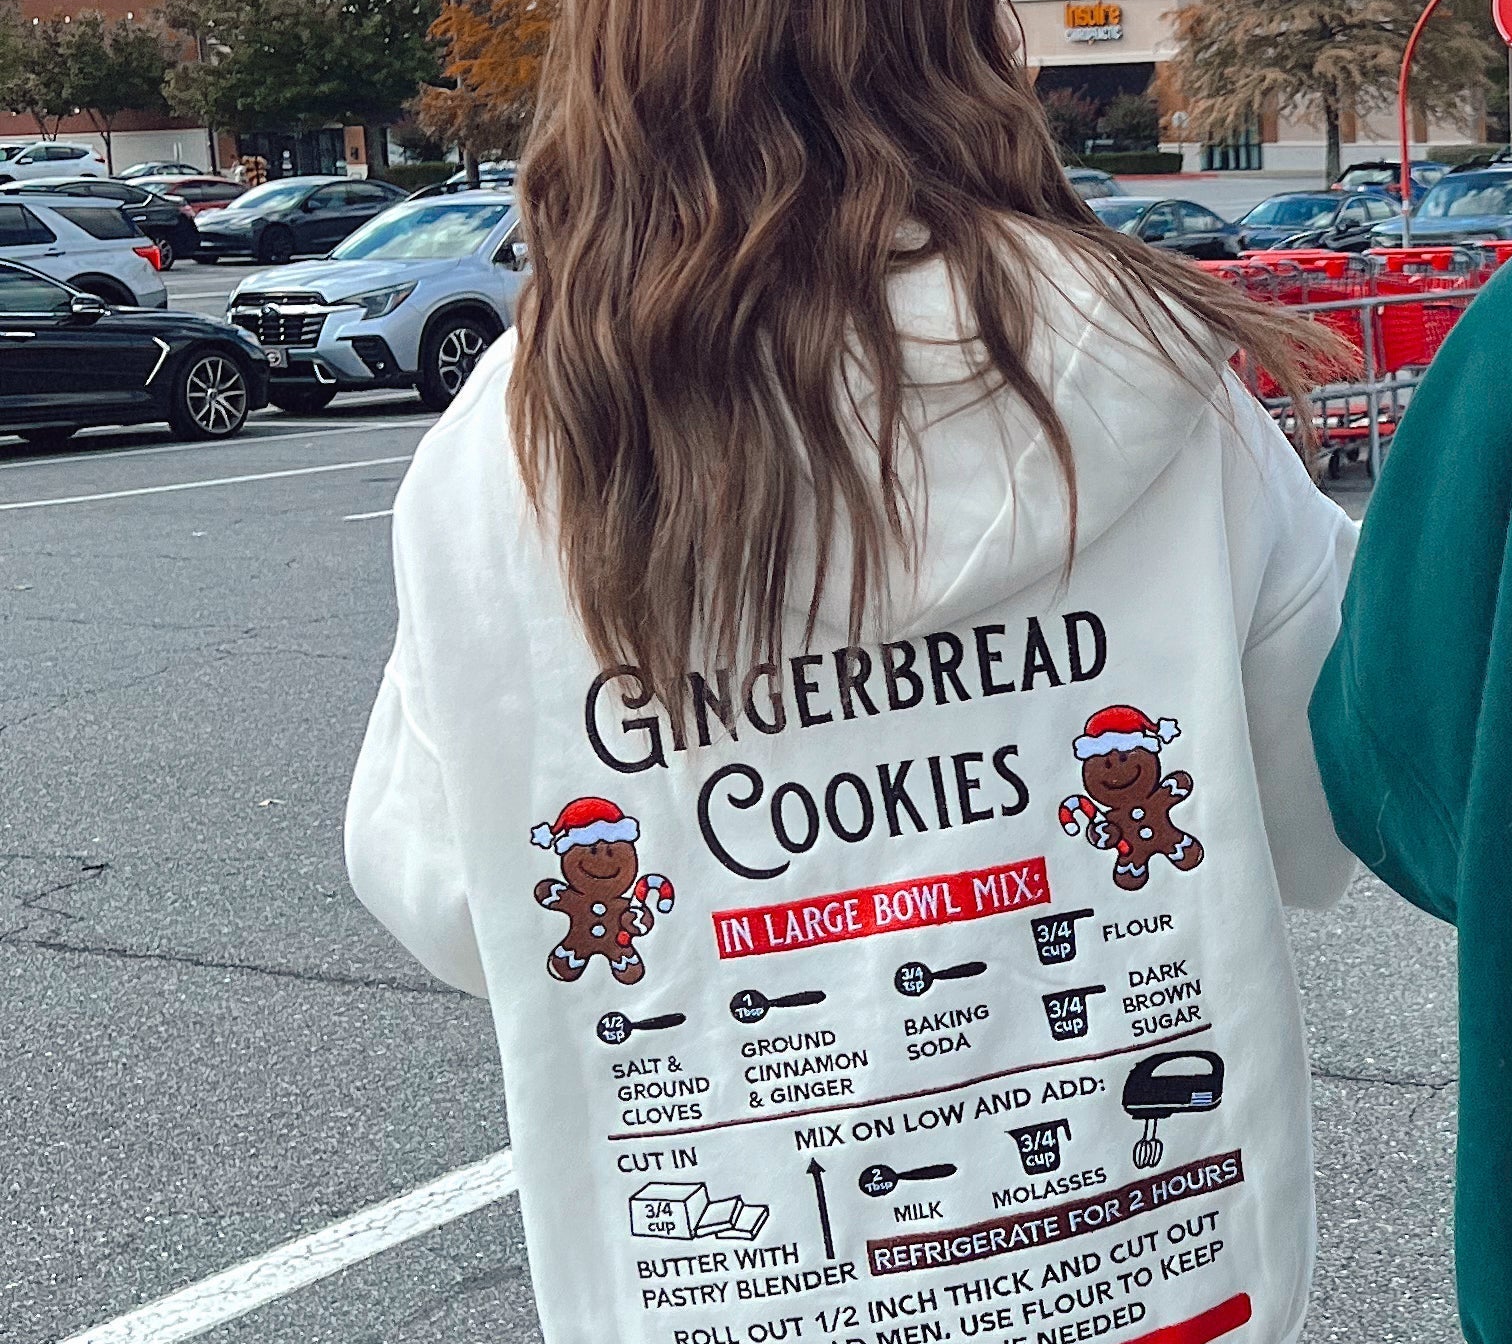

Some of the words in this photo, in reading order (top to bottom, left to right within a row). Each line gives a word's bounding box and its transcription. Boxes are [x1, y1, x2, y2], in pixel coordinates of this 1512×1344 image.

[697, 744, 1030, 880] COOKIES
[720, 916, 754, 952] IN
[763, 899, 863, 947] LARGE
[871, 883, 961, 926] BOWL
[972, 866, 1044, 911] MIX:
[1037, 920, 1072, 943] 3/4
[1102, 914, 1174, 942] FLOUR
[1041, 942, 1071, 959] cup
[1128, 959, 1188, 988] DARK
[1048, 996, 1084, 1019] 3/4
[1122, 979, 1202, 1014] BROWN
[904, 1004, 990, 1037] BAKING
[1053, 1017, 1084, 1035] cup
[1131, 1005, 1202, 1038] SUGAR
[741, 1030, 836, 1058] GROUND
[906, 1032, 972, 1061] SODA
[612, 1058, 661, 1080] SALT
[667, 1055, 683, 1073] &
[744, 1050, 869, 1084] CINNAMON
[617, 1076, 710, 1102] GROUND
[749, 1091, 765, 1108] &
[770, 1078, 855, 1104] GINGER
[622, 1103, 703, 1126] CLOVES
[794, 1123, 846, 1151] MIX
[851, 1118, 895, 1142] ON
[903, 1101, 965, 1133] LOW
[974, 1087, 1032, 1120] AND
[1041, 1076, 1107, 1104] ADD:
[1020, 1130, 1055, 1153] 3/4
[617, 1151, 665, 1173] CUT
[671, 1146, 698, 1169] IN
[1025, 1152, 1056, 1169] cup
[871, 1168, 883, 1182] 2
[991, 1167, 1107, 1209] MOLASSES
[644, 1202, 673, 1219] 3/4
[874, 1215, 1060, 1271] REFRIGERATE
[1068, 1198, 1121, 1233] FOR
[1128, 1188, 1145, 1208] 2
[1151, 1158, 1238, 1203] HOURS
[893, 1200, 944, 1223] MILK
[647, 1220, 676, 1235] cup
[637, 1252, 730, 1279] BUTTER
[734, 1242, 799, 1270] WITH
[642, 1281, 729, 1309] PASTRY
[736, 1261, 858, 1300] BLENDER
[749, 1316, 804, 1344] OUT
[815, 1306, 860, 1334] 1/2
[867, 1288, 939, 1324] INCH
[943, 1269, 1034, 1306] THICK
[1041, 1252, 1101, 1289] AND
[1109, 1229, 1160, 1265] CUT
[1167, 1210, 1220, 1245] OUT
[960, 1308, 1013, 1338] USE
[1022, 1280, 1114, 1325] FLOUR
[1117, 1267, 1153, 1295] TO
[1160, 1239, 1225, 1281] KEEP
